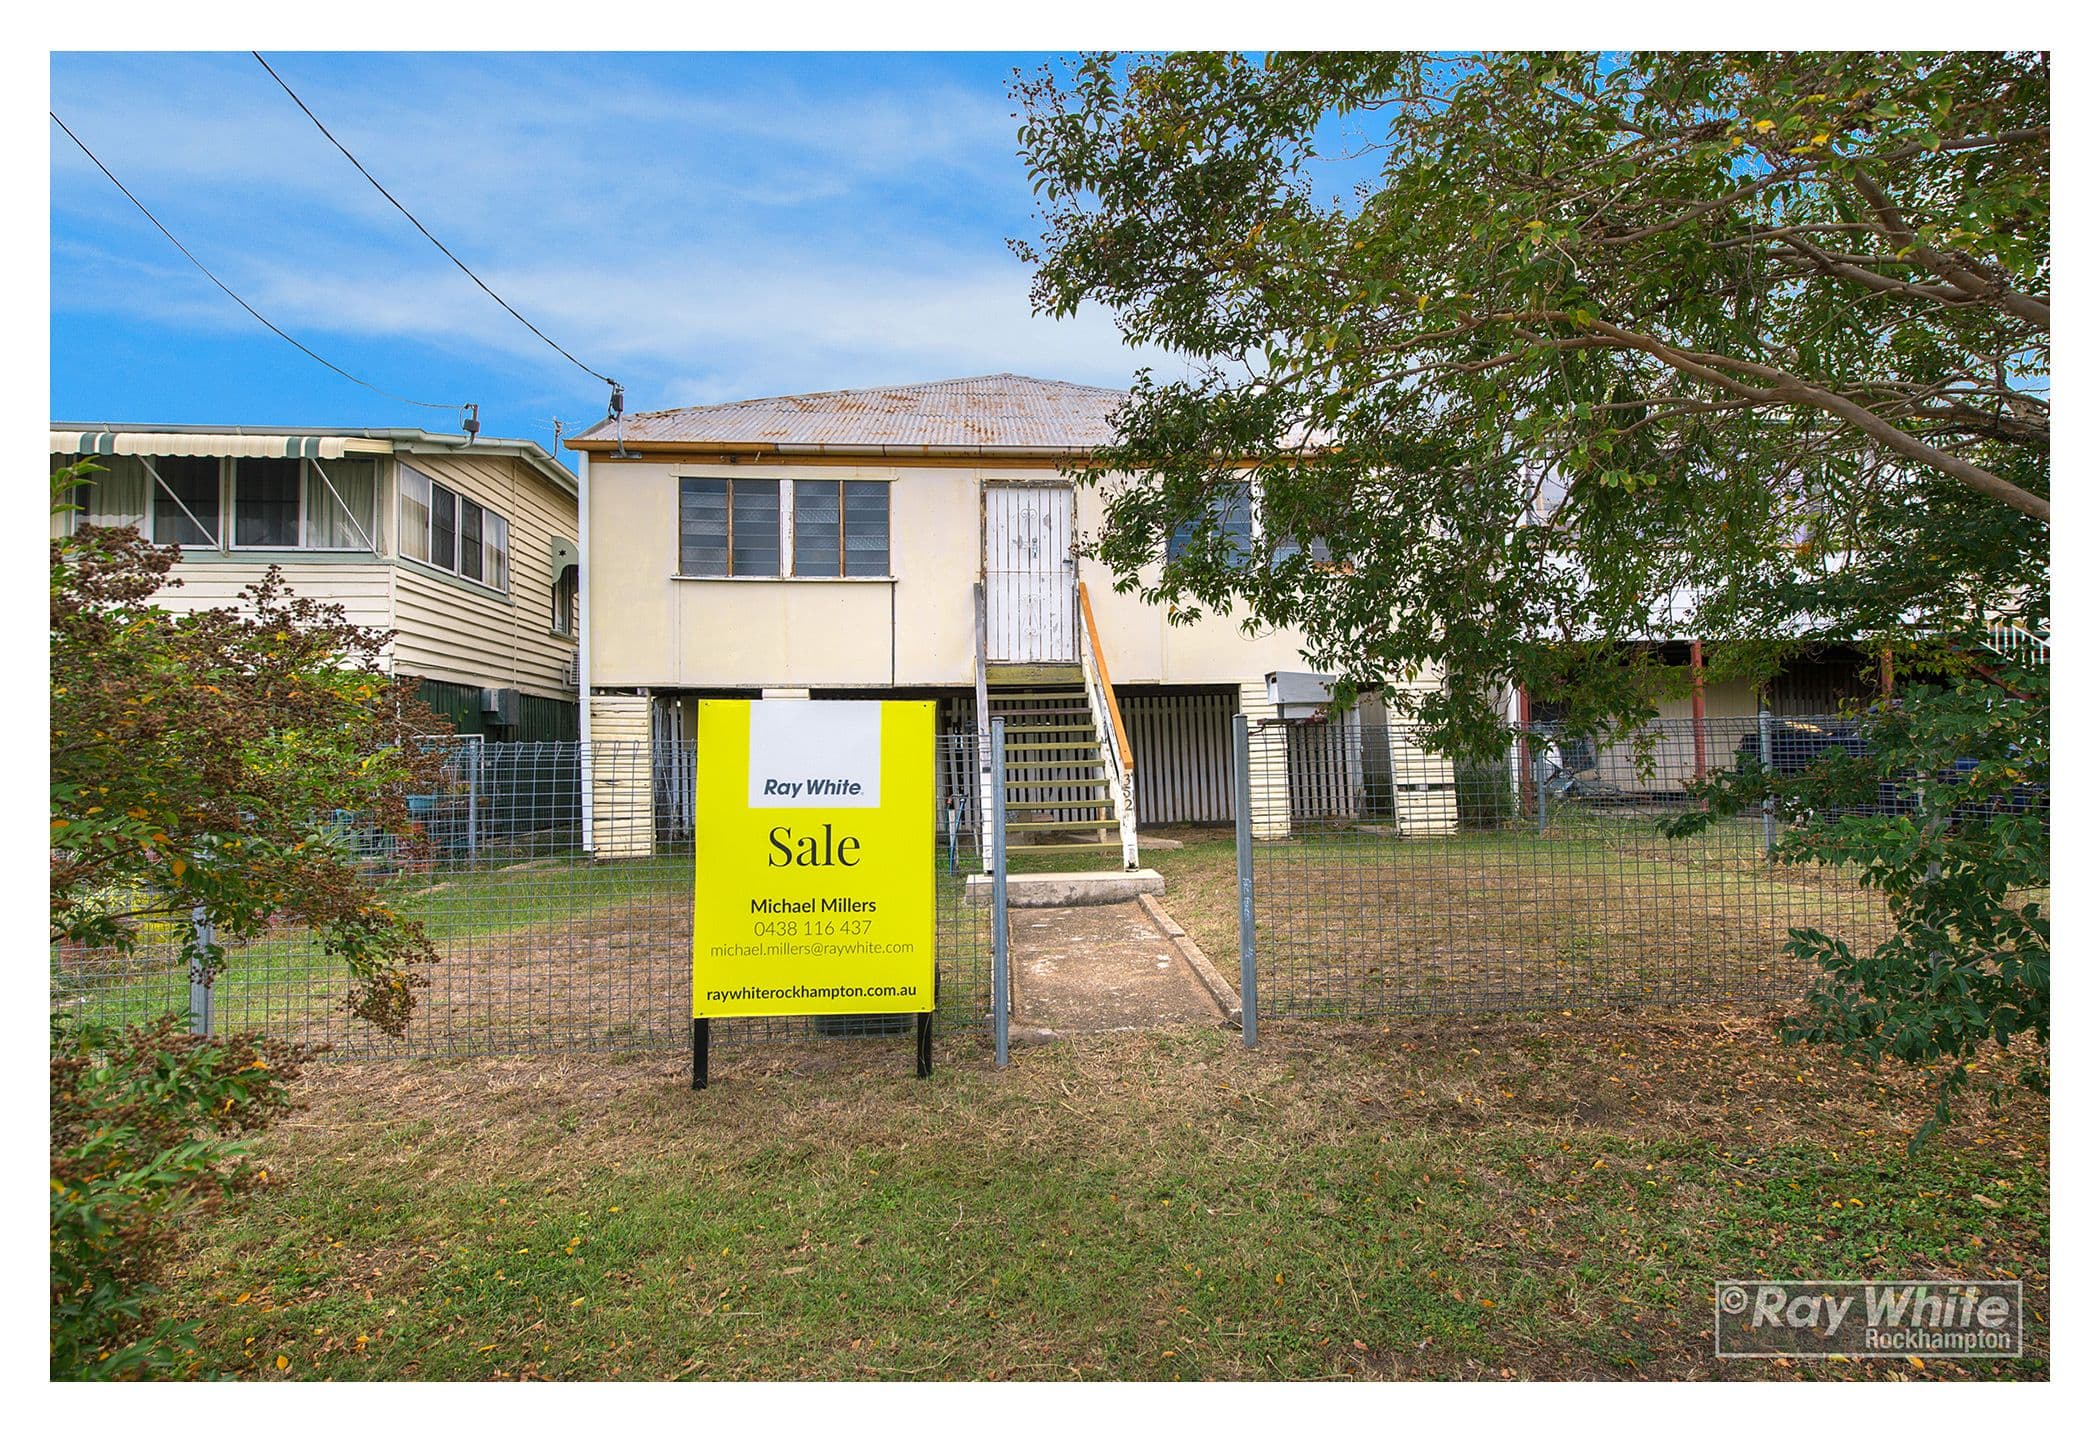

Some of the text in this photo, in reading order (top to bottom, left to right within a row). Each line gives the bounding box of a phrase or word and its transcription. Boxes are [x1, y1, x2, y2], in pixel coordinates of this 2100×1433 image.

[764, 779, 861, 798] Ray White
[1123, 773, 1133, 811] 352
[768, 824, 860, 867] Sale
[751, 897, 876, 914] Michael Millers
[754, 920, 872, 937] 0438 116 437
[711, 941, 914, 958] michael.millers@raywhite.com
[707, 985, 917, 1001] raywhiterockhampton.com.au
